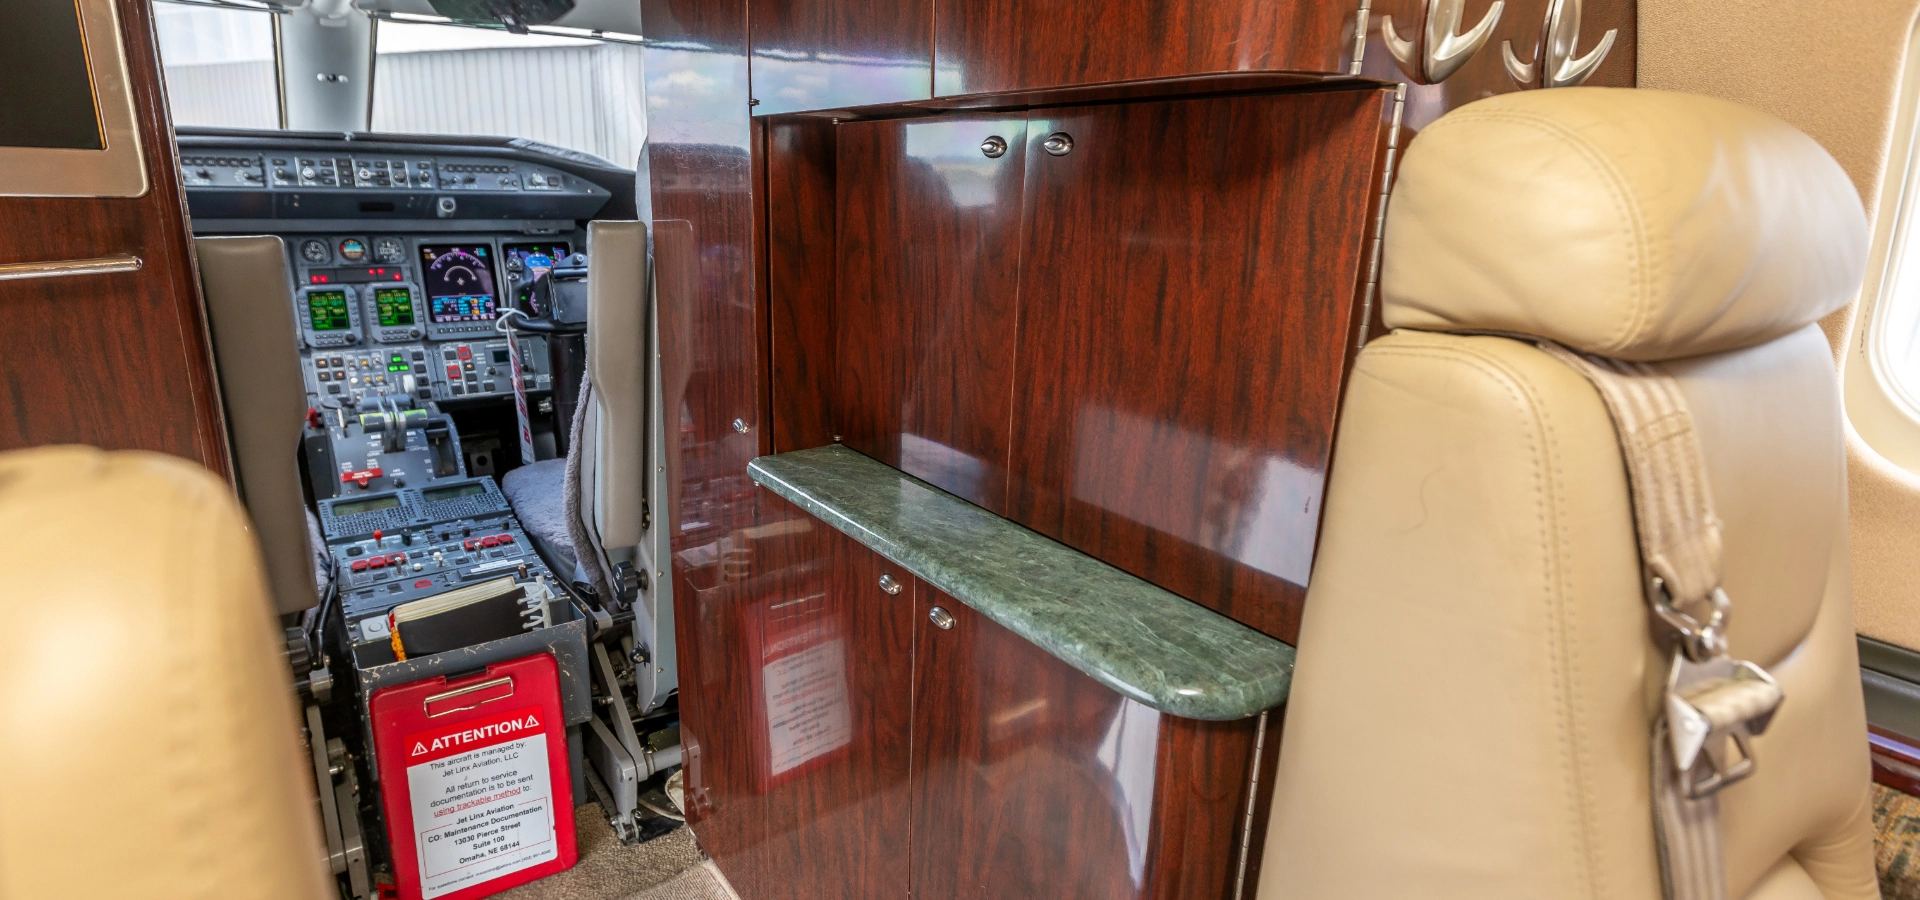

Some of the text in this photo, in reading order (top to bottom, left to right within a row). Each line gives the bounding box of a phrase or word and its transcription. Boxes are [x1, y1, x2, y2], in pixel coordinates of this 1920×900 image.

[430, 718, 523, 751] ATTENTION
[430, 762, 445, 771] This
[447, 754, 472, 766] aircraft
[481, 744, 514, 757] managed
[515, 741, 527, 751] by:
[442, 769, 454, 778] Jet
[455, 765, 471, 774] Linx
[504, 752, 519, 761] LLC
[430, 788, 487, 808] documentation
[506, 778, 516, 786] be
[517, 774, 534, 784] sent
[445, 786, 455, 794] All
[457, 779, 480, 790] return
[491, 770, 518, 782] service
[433, 784, 532, 818] using trackable method to:
[456, 803, 515, 825] Jet Linx Aviation
[428, 805, 543, 843] CO: Maintenance Documentation
[454, 821, 521, 846] 13030 Pierce Street
[472, 835, 505, 850] Suite 100
[459, 853, 487, 864] Omaha,
[488, 848, 498, 856] NE
